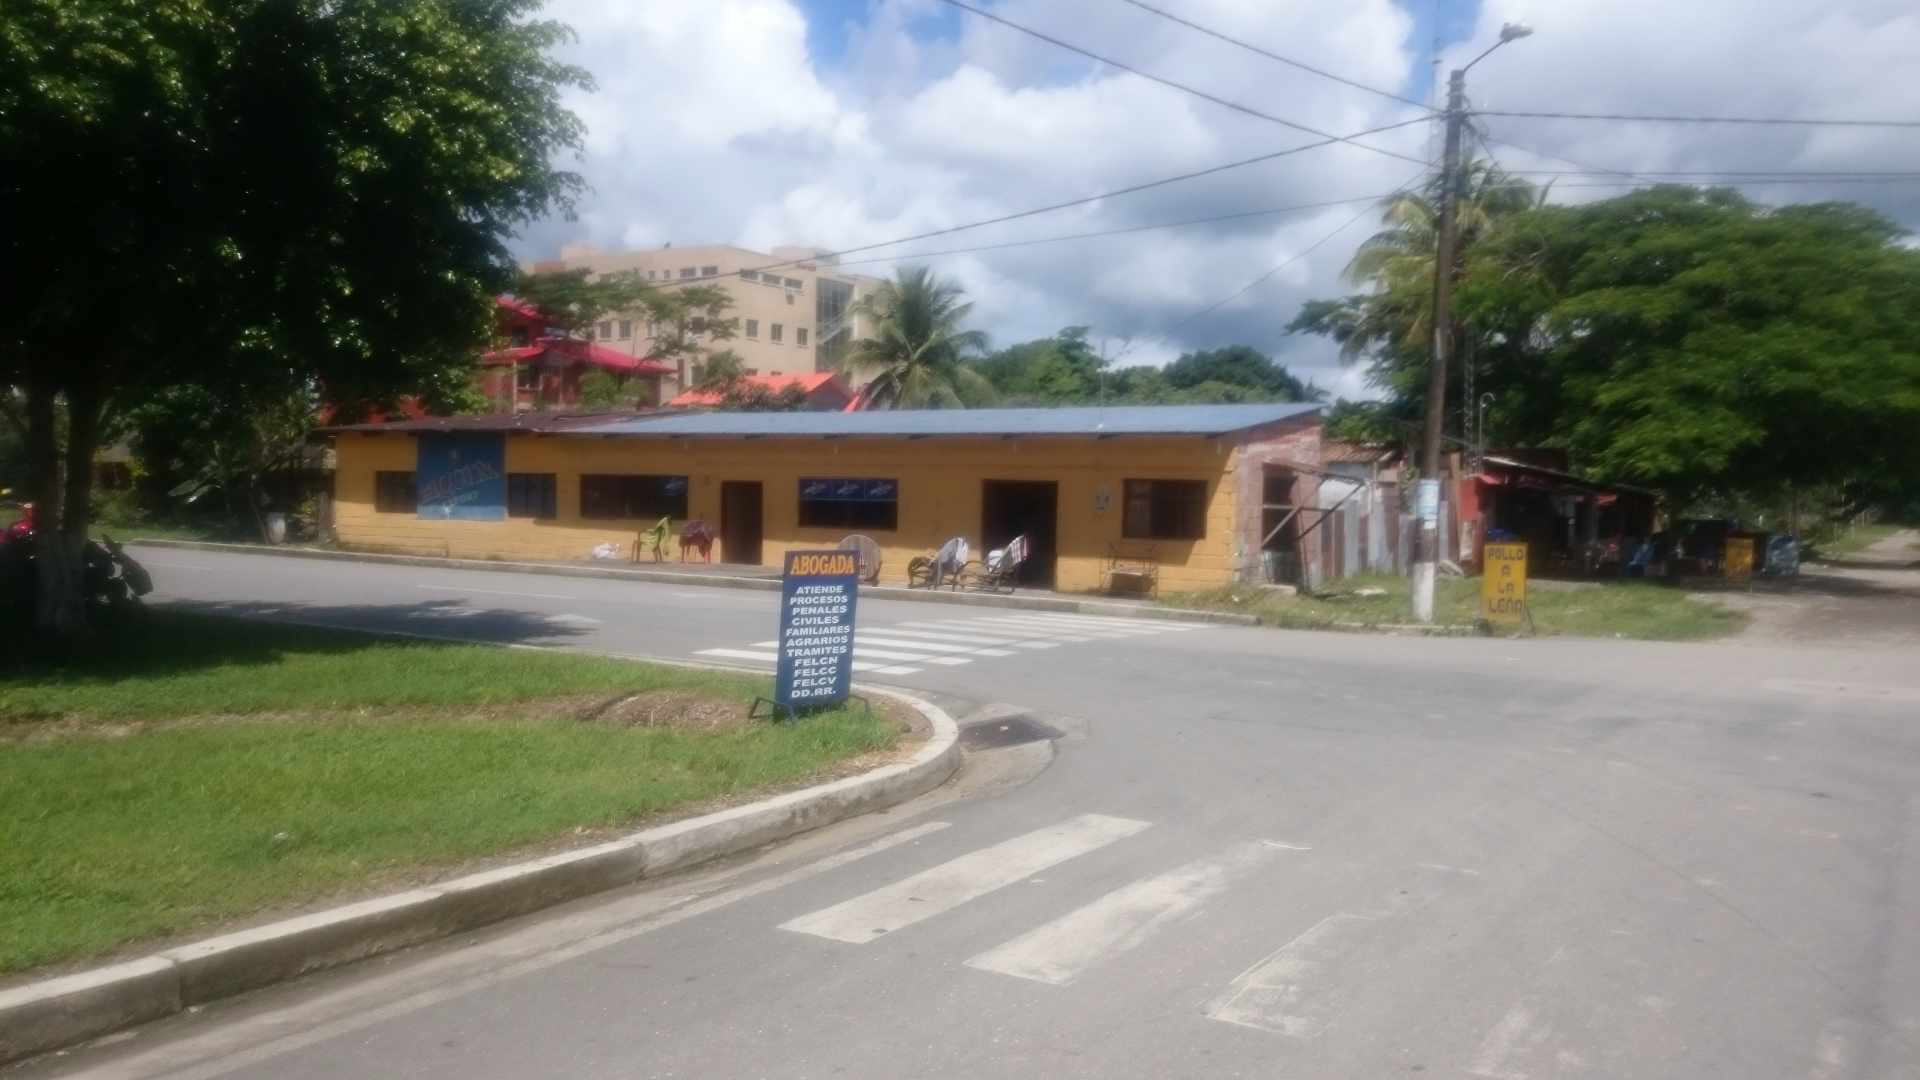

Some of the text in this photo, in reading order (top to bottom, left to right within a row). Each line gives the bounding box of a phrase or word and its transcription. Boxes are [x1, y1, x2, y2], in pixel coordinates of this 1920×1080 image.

[790, 555, 855, 575] ABOGADA
[796, 585, 844, 594] ATIENDE
[790, 595, 848, 605] PROCESOS
[792, 605, 848, 615] PENALES
[791, 616, 840, 626] CIVILES
[786, 625, 850, 636] FAMILIARES
[786, 635, 848, 647] AGRARIOS
[786, 646, 847, 657] TRAMITES
[794, 656, 838, 667] FELCN
[794, 666, 837, 677] FELCC
[793, 677, 837, 687] FELCV
